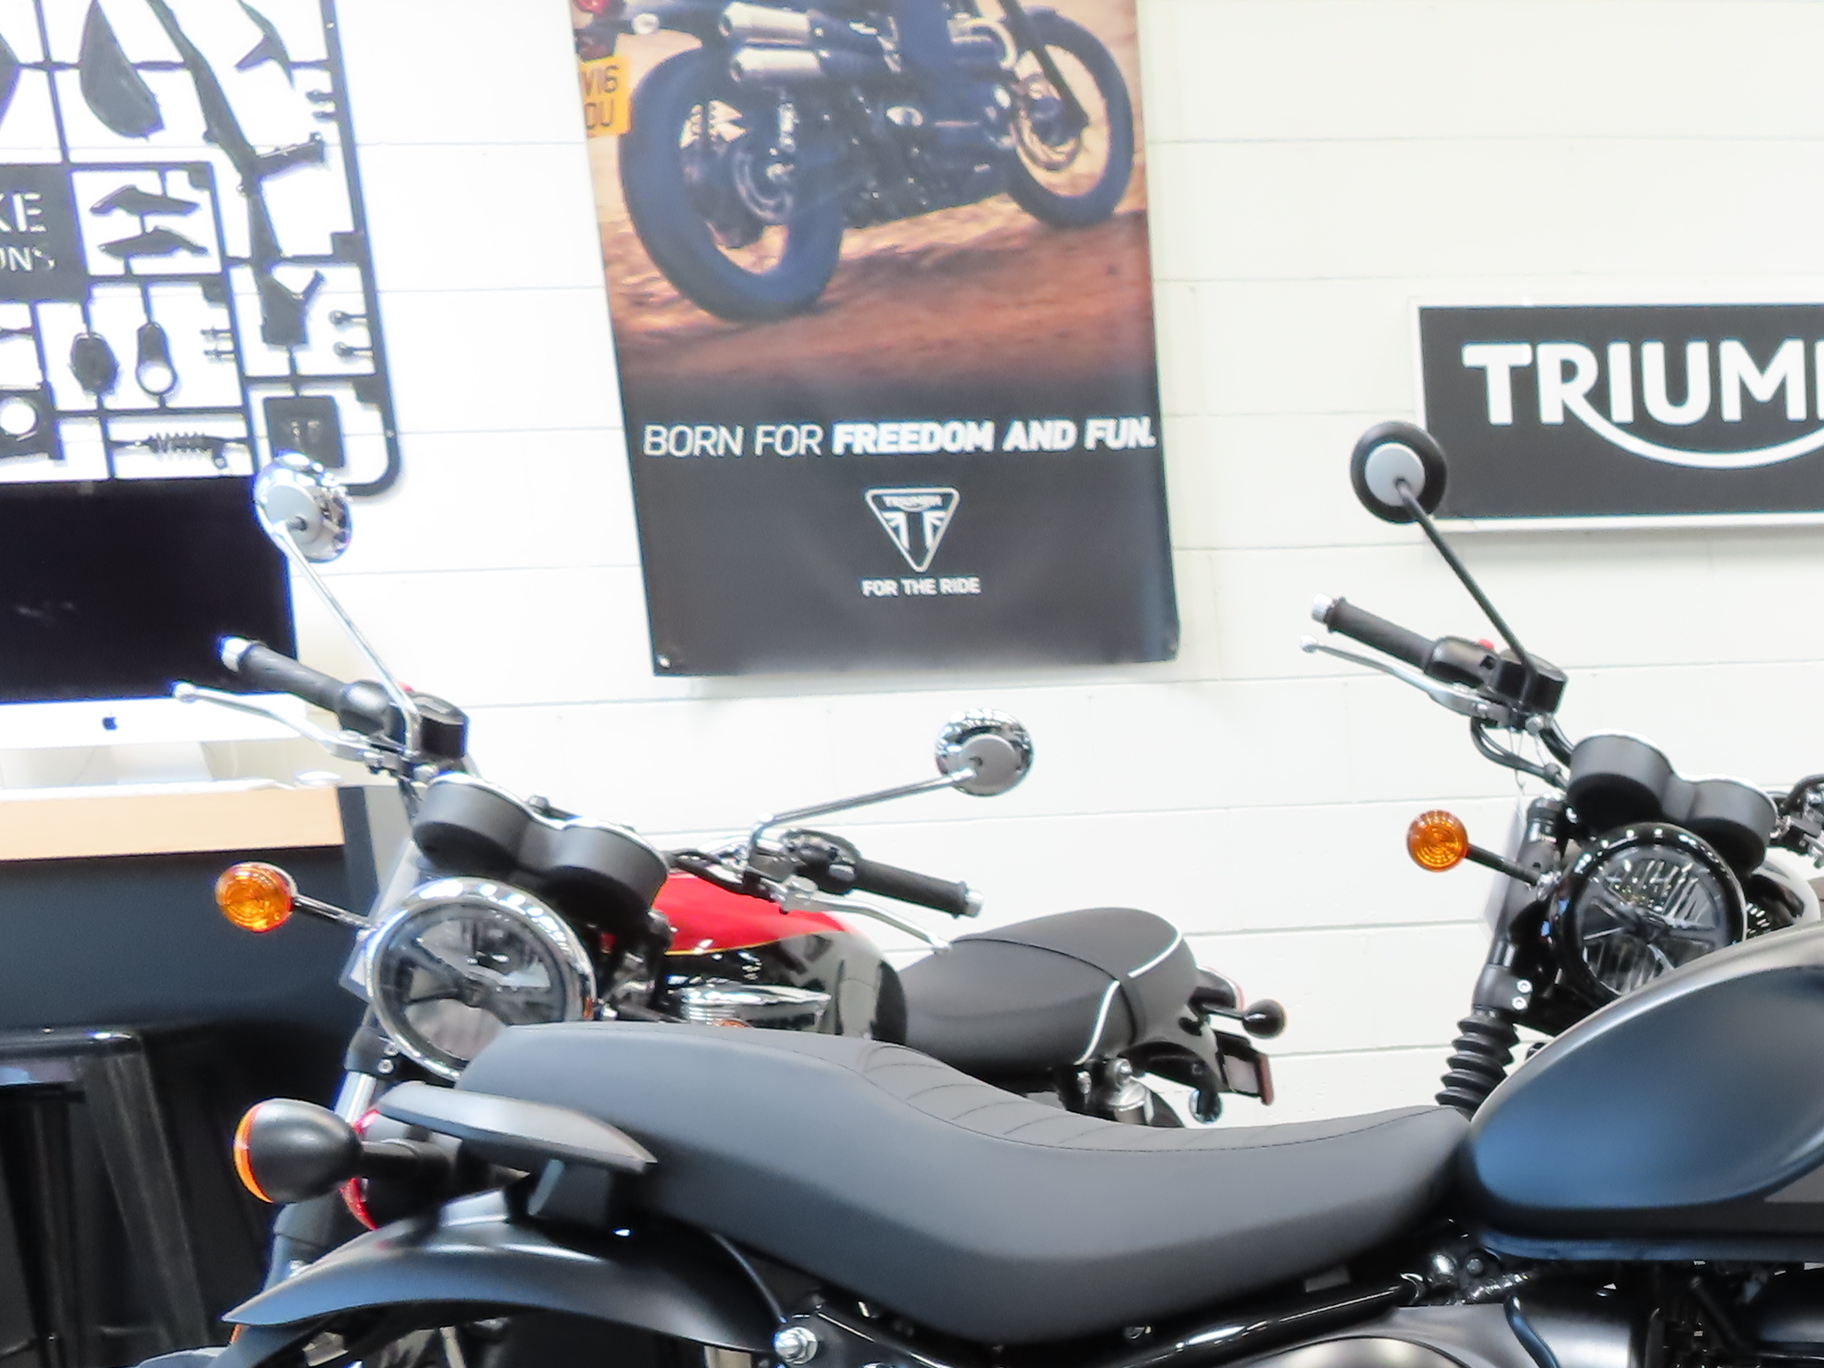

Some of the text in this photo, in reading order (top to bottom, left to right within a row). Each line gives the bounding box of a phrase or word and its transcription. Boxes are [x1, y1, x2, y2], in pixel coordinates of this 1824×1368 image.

[643, 416, 1157, 457] BORN FOR FREEDOM AND FUN.
[861, 577, 981, 597] FOR THE RIDE
